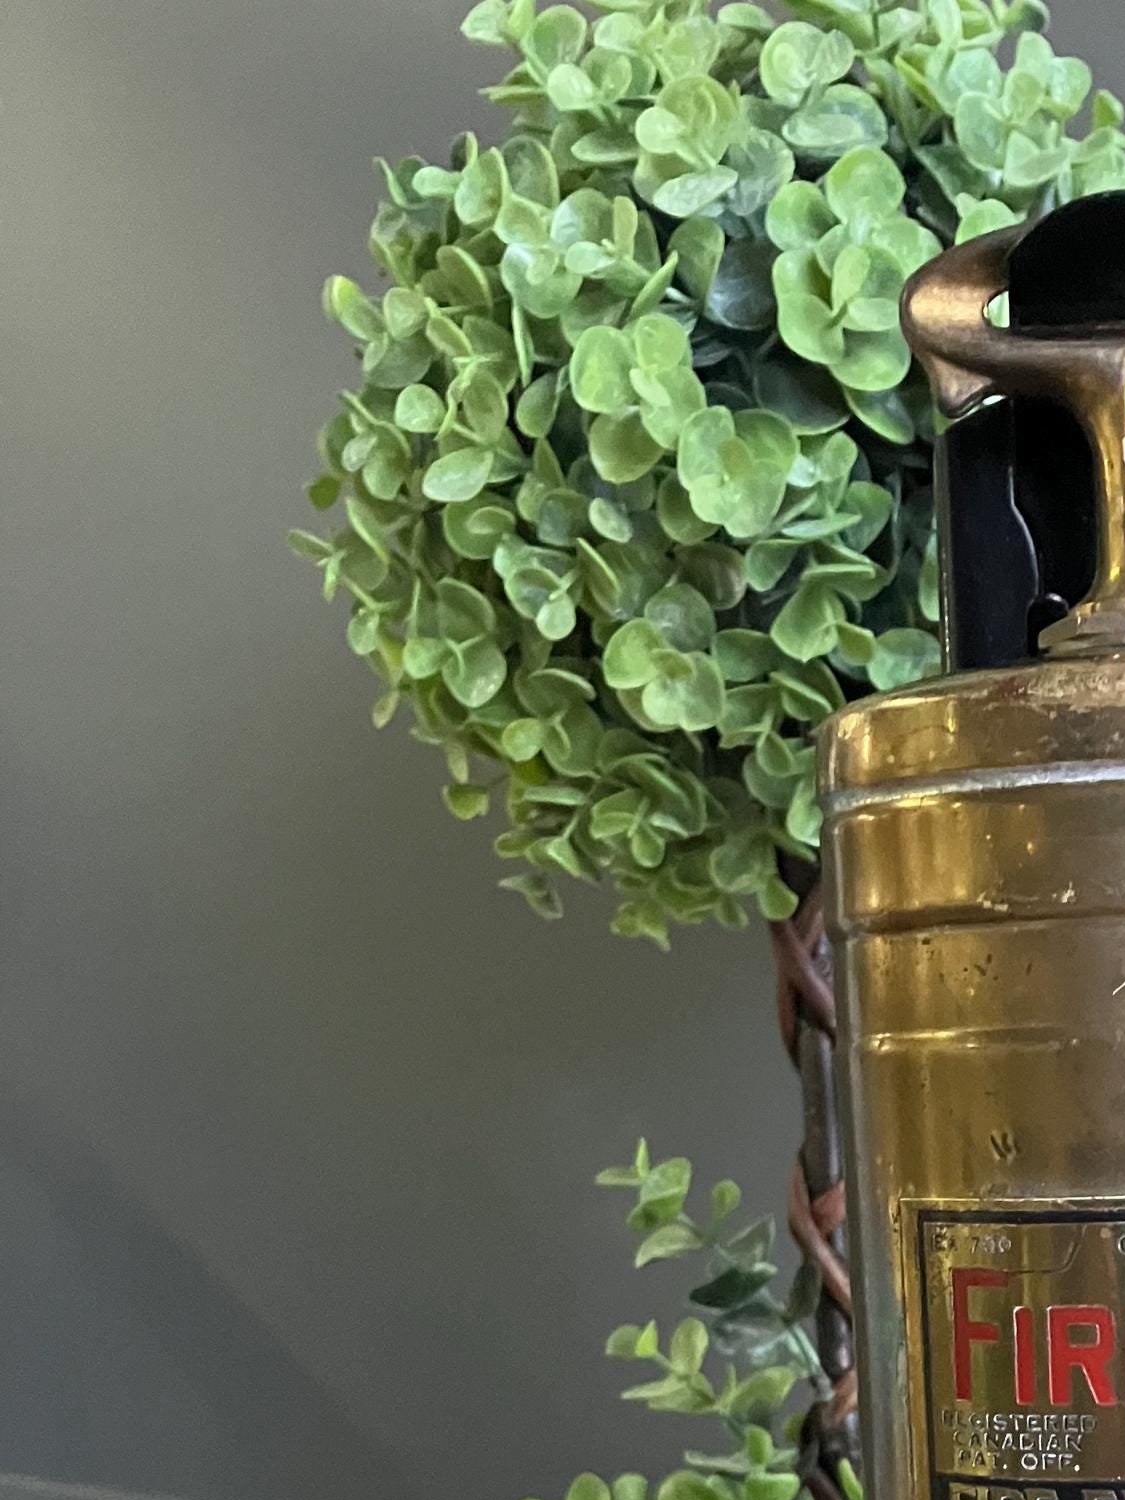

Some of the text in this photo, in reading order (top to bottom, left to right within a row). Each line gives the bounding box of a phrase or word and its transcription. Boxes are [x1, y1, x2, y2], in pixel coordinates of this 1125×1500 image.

[942, 1410, 1097, 1432] REGISTERED
[953, 1431, 1083, 1452] CANADIAN
[958, 1450, 1081, 1472] PAT. OFF.
